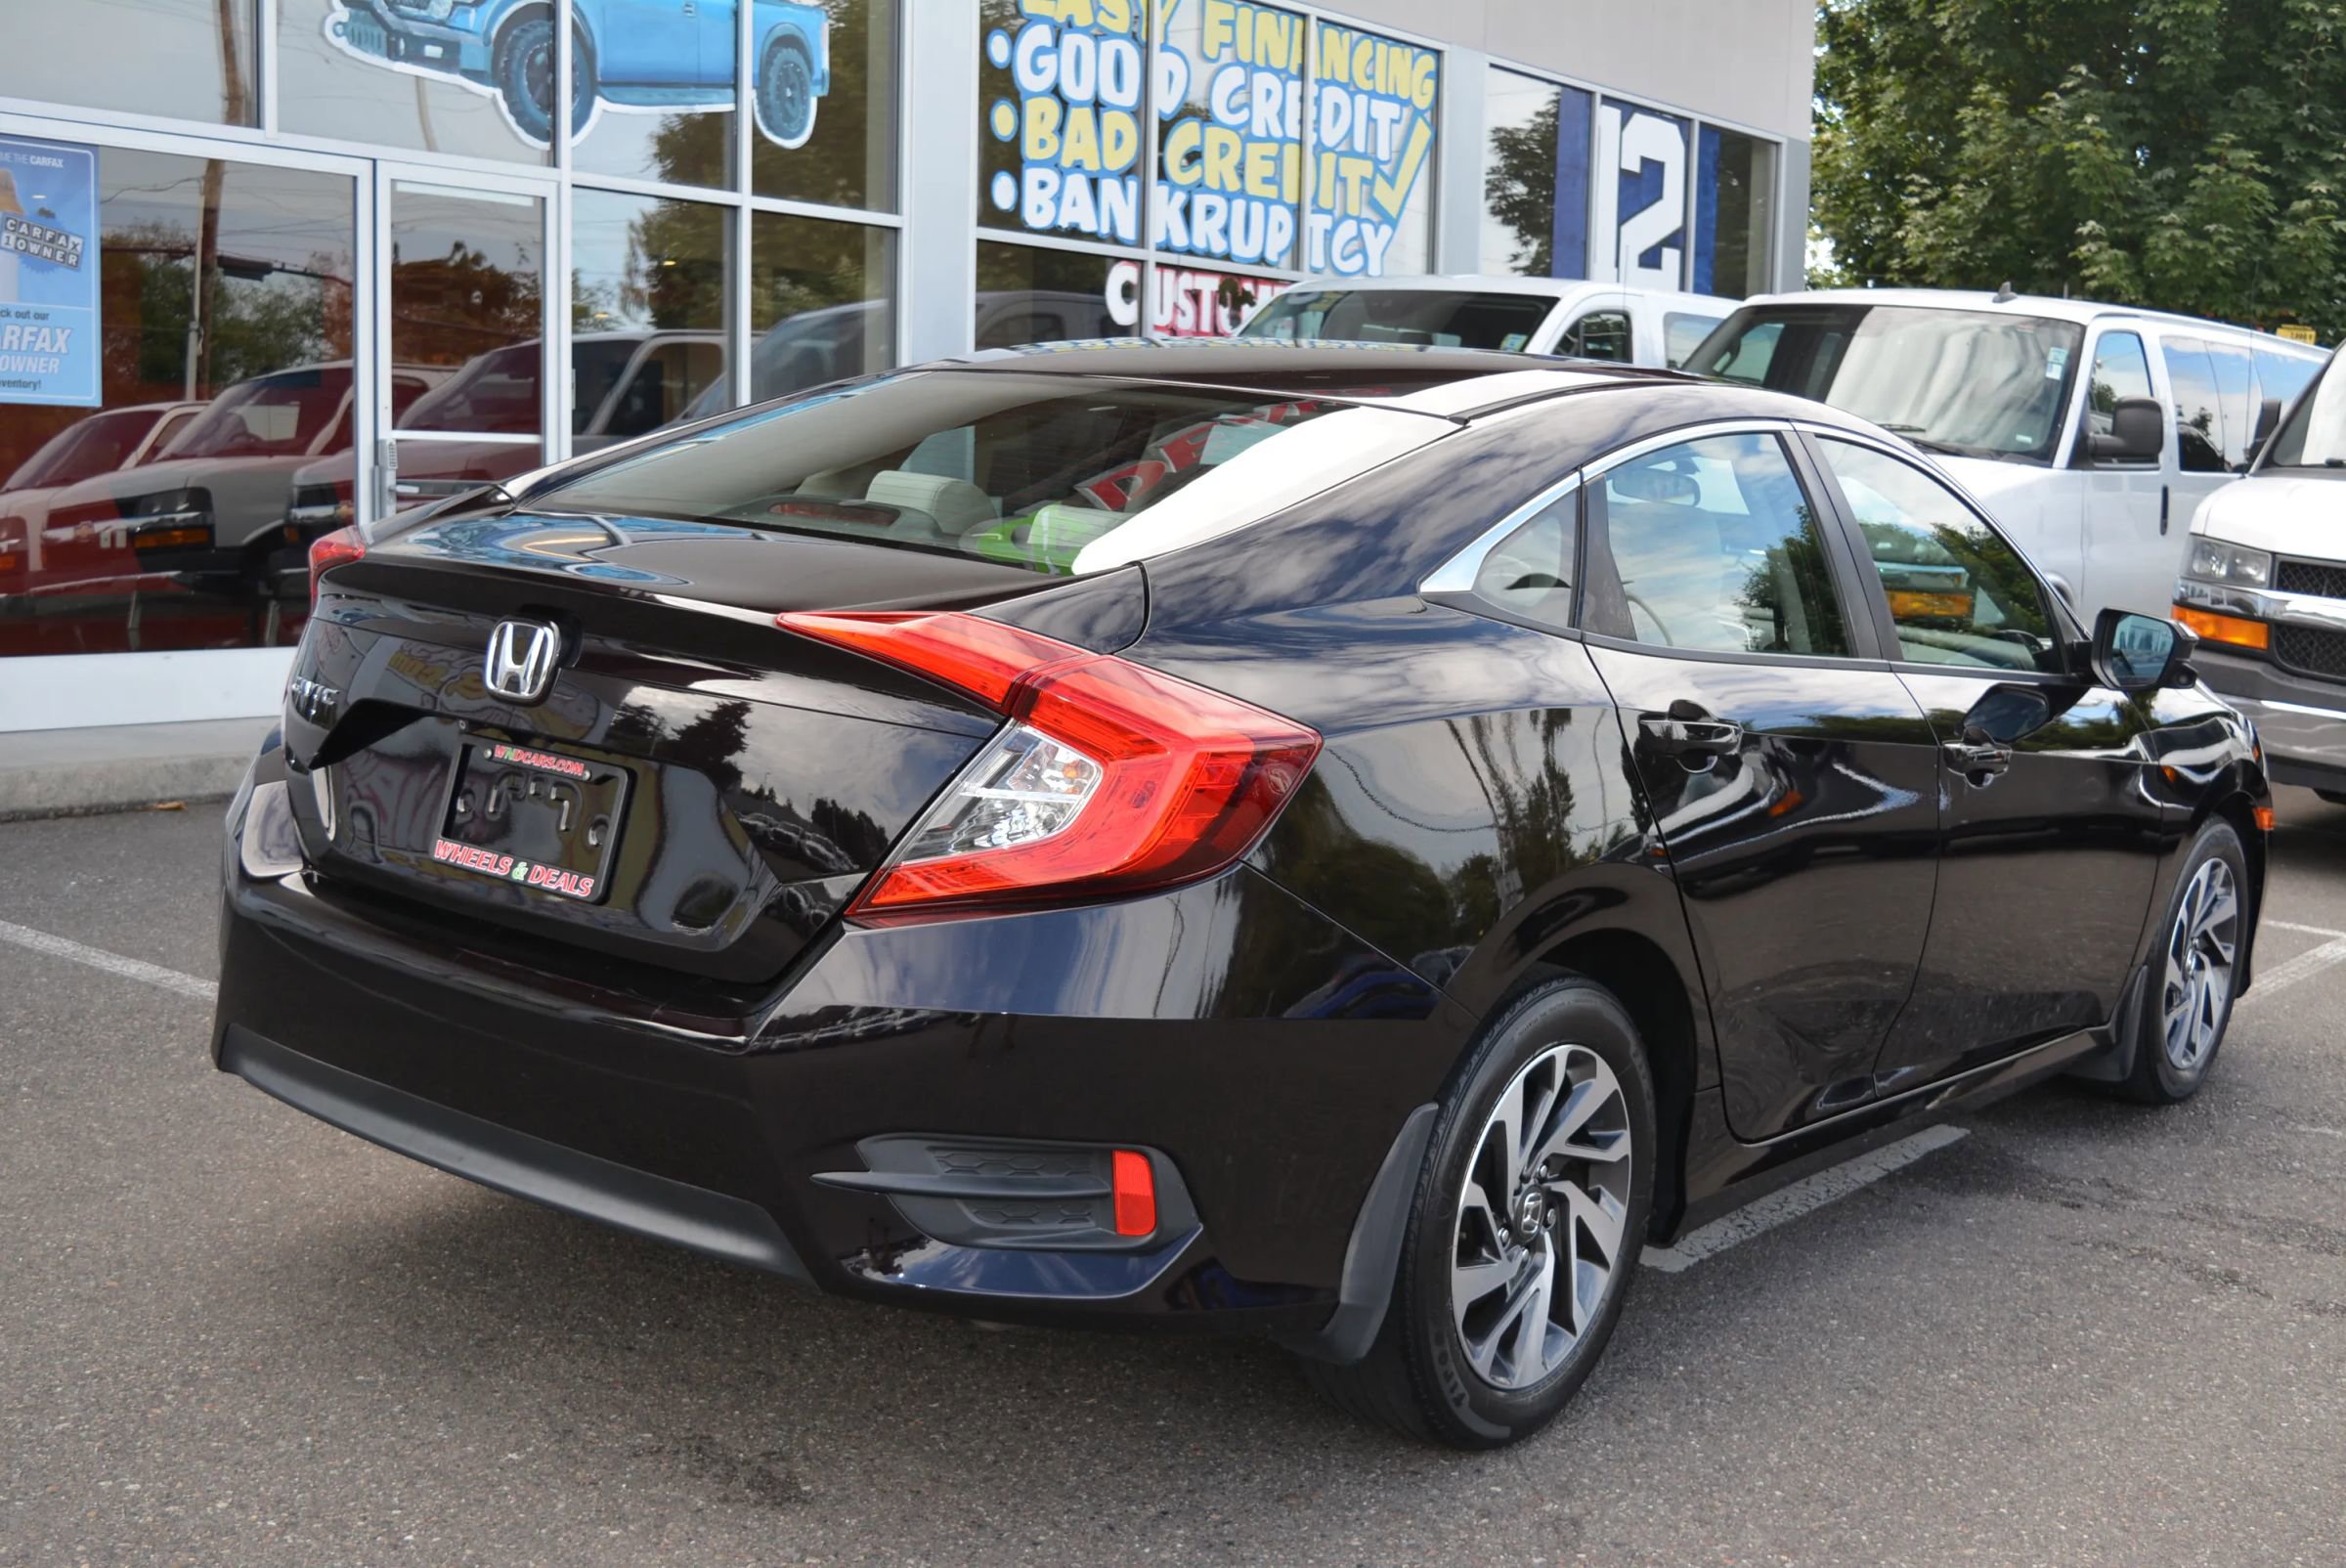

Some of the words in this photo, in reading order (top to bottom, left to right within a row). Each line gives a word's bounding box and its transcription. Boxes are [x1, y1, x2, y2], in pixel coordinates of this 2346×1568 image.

[1202, 2, 1437, 111] FINANCING
[1016, 22, 1190, 116] GOOD
[1211, 65, 1402, 163] CREDIT
[29, 155, 64, 168] CARFAX
[1022, 95, 1140, 171] BAD
[6, 218, 82, 252] CARFAX
[1021, 166, 1395, 278] BANKRUPTCY
[15, 311, 30, 320] out
[33, 312, 50, 321] our
[433, 839, 514, 876] WHEELS
[510, 861, 529, 882] &
[527, 864, 595, 898] DEALS
